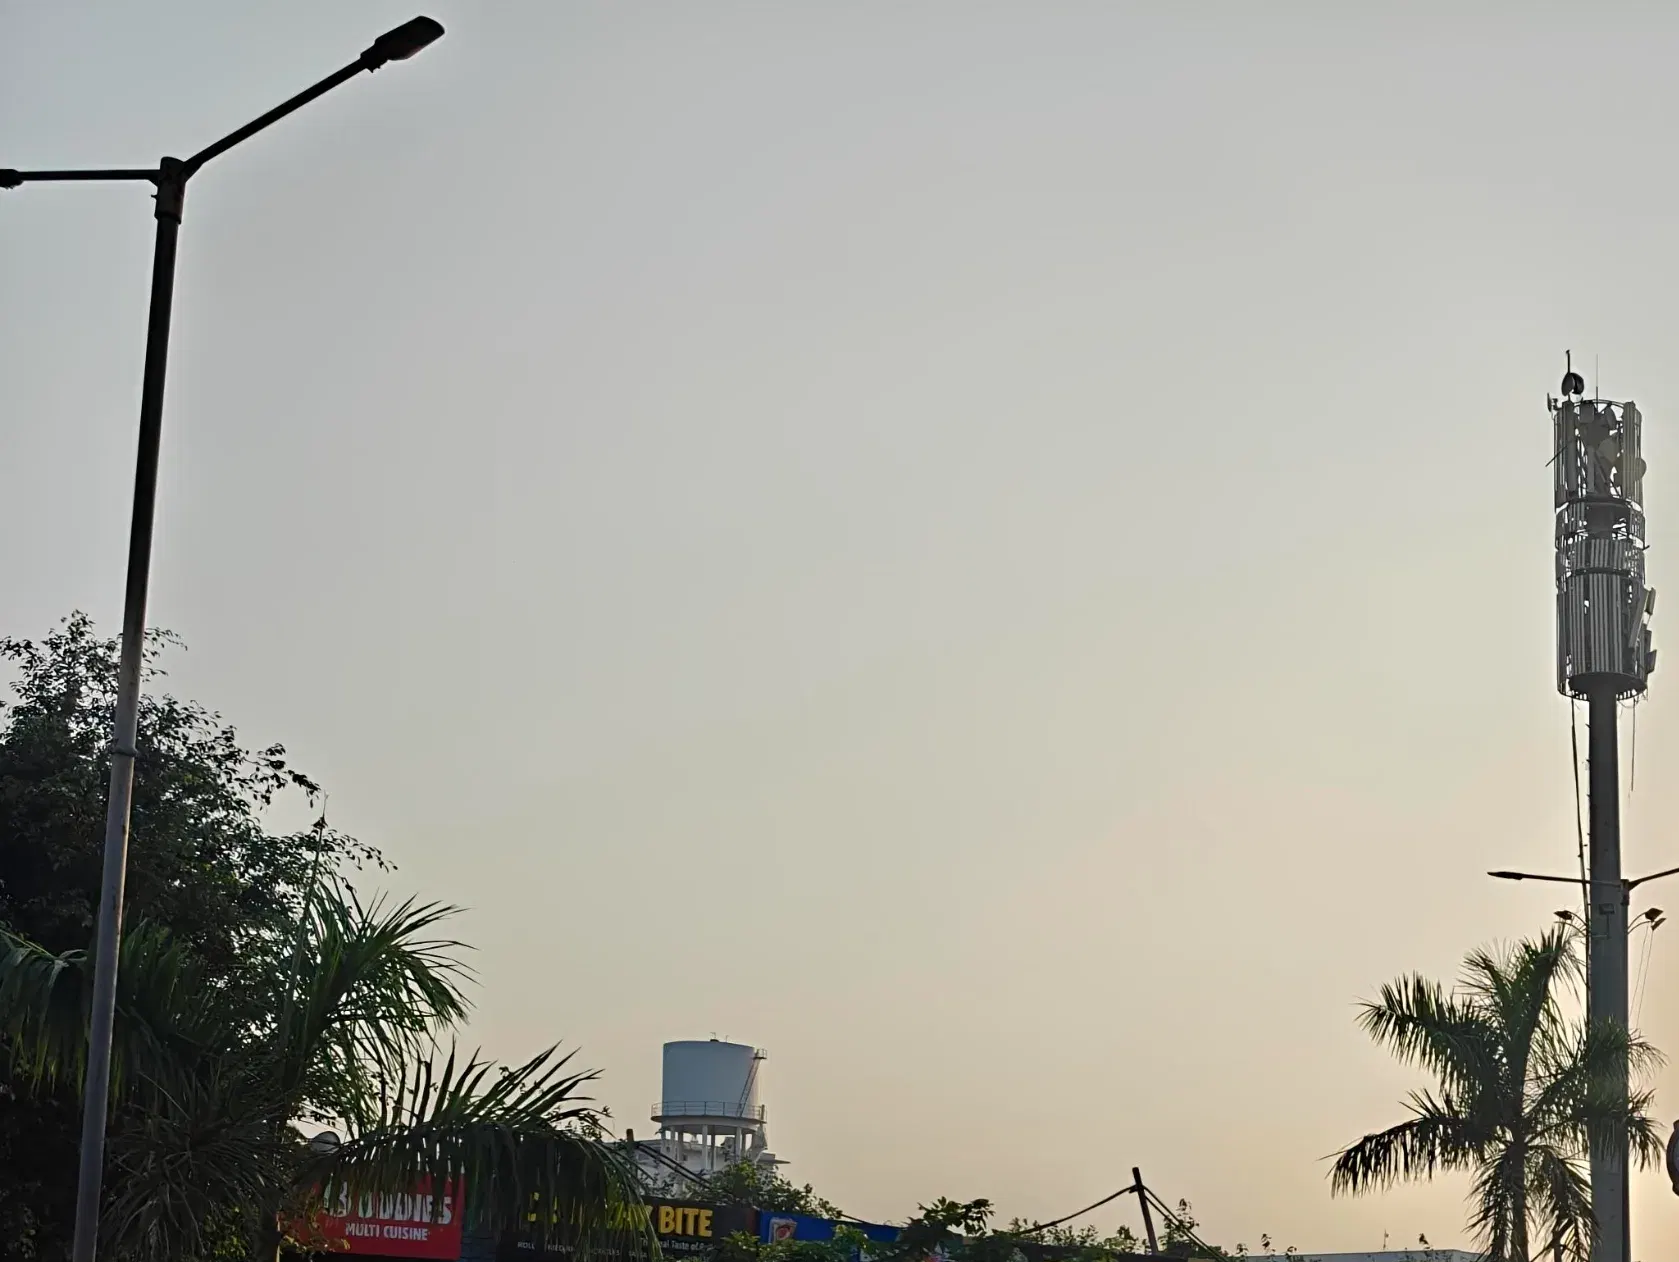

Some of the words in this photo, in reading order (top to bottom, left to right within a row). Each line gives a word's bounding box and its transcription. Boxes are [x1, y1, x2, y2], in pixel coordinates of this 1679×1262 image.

[345, 1223, 380, 1238] MULTI
[383, 1226, 430, 1241] CUISINE
[658, 1205, 714, 1239] BITE
